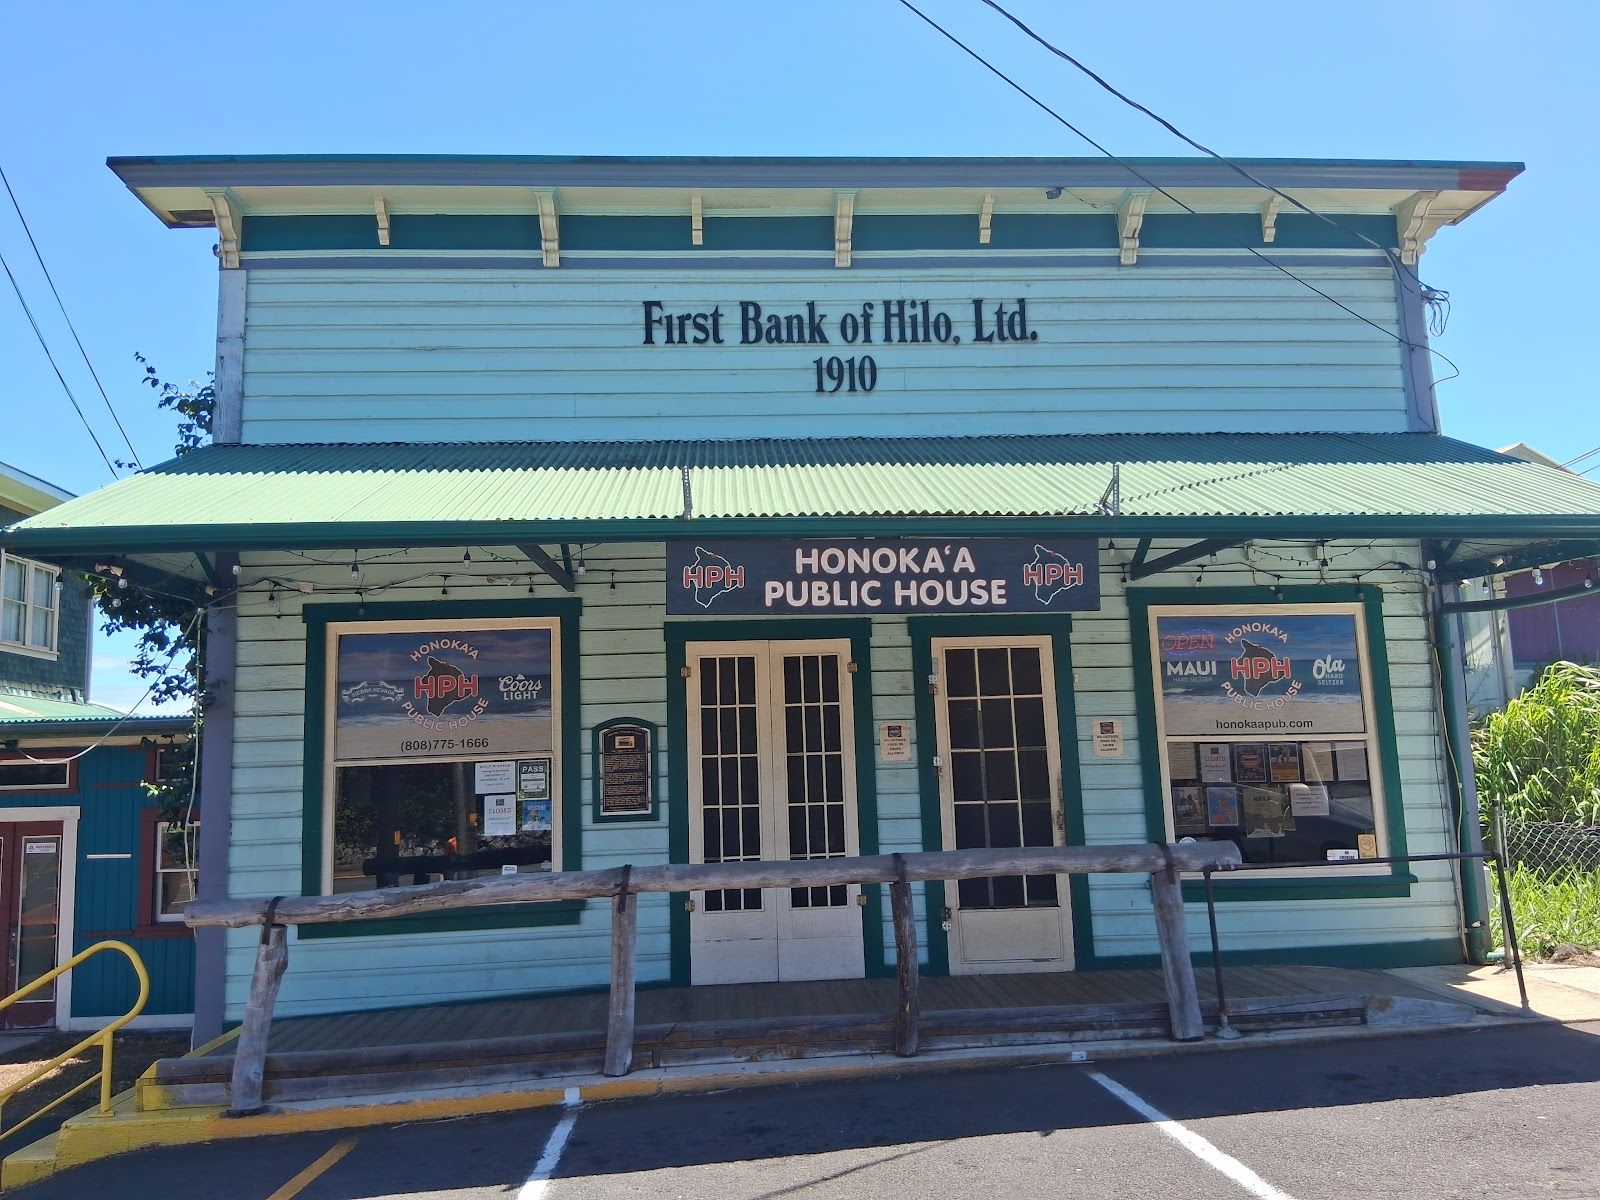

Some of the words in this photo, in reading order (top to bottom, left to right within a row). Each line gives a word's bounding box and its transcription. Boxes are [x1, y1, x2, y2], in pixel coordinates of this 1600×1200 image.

[642, 301, 724, 345] First
[739, 300, 830, 345] Bank
[839, 302, 875, 344] of
[883, 299, 961, 345] Hilo,
[973, 298, 1038, 343] Ltd.
[812, 355, 878, 393] 1910
[683, 565, 745, 589] HPH
[1023, 562, 1084, 587] HPH
[764, 580, 882, 607] PUBLIC
[894, 579, 1008, 606] HOUSE
[1161, 634, 1216, 651] OPEN
[1166, 660, 1217, 676] MAUI
[1231, 656, 1292, 680] HPH
[1312, 654, 1346, 680] Ola
[414, 673, 479, 699] HPH
[498, 675, 543, 692] Coors
[1220, 681, 1263, 711] PUBLIC
[1266, 679, 1303, 711] HOUSE
[503, 691, 538, 701] LIGHT
[401, 701, 444, 731] PUBLIC
[448, 697, 489, 731] HOUSE
[1215, 719, 1314, 731] honokaapub.com
[400, 737, 489, 752] (808)775-1666
[522, 765, 544, 773] PASS
